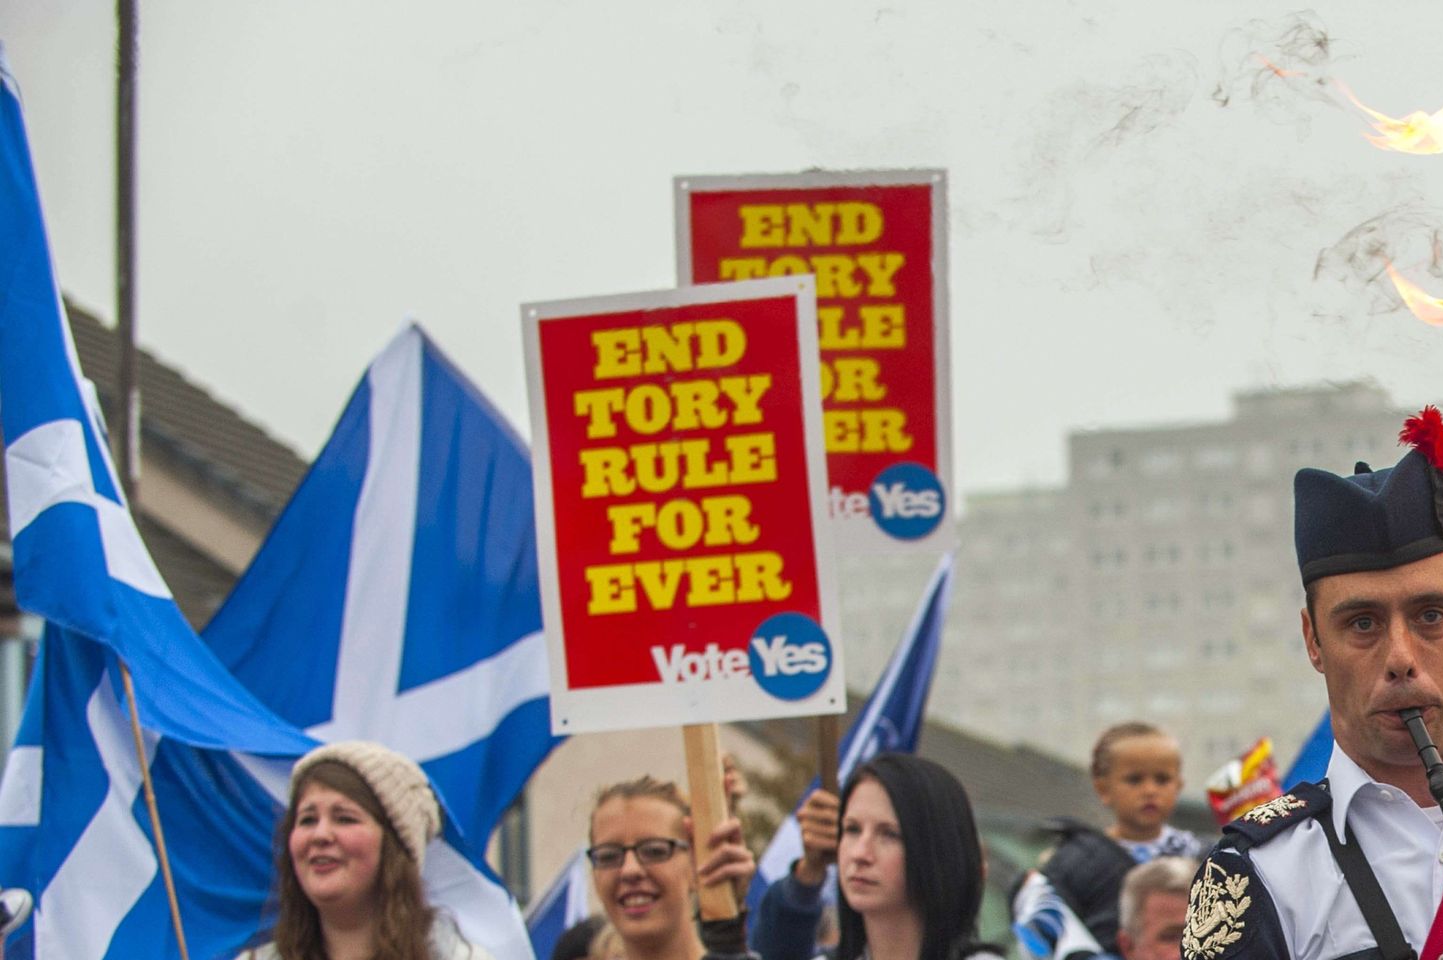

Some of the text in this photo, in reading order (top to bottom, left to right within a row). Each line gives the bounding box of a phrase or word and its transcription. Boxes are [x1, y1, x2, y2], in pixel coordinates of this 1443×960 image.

[739, 202, 884, 248] END
[591, 319, 747, 379] END
[818, 304, 906, 349] LE
[574, 374, 772, 439] TORY
[823, 408, 914, 453] ER
[579, 432, 778, 498] RULE
[608, 495, 760, 554] FOR
[873, 481, 941, 519] Yes
[585, 551, 792, 616] EVER
[651, 635, 827, 685] Vote Yes
